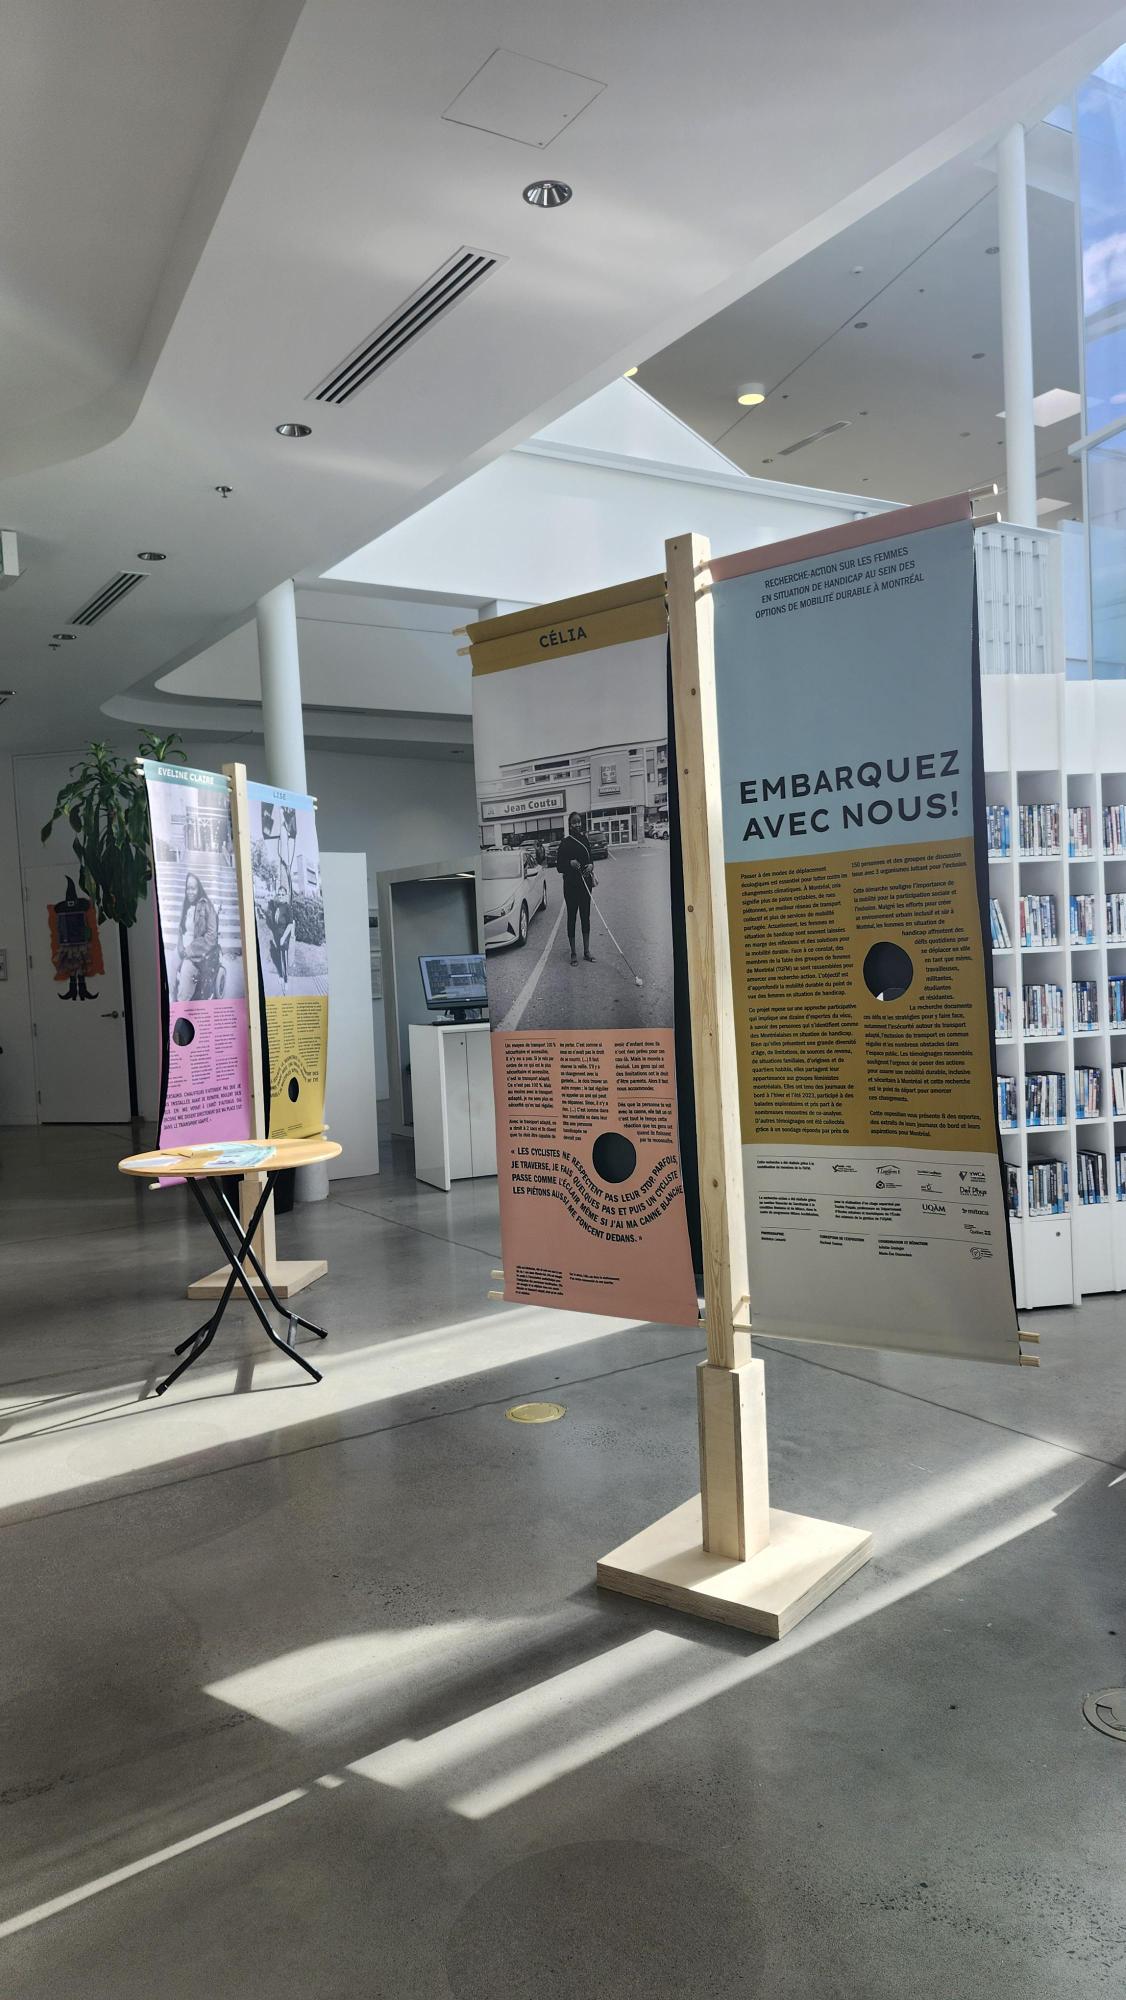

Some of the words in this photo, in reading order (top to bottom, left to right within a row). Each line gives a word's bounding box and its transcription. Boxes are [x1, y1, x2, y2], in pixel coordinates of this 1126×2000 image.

[761, 595, 772, 603] EN
[774, 585, 810, 601] SITUATION
[812, 583, 822, 592] DE
[824, 572, 863, 590] HANDICAP
[865, 570, 876, 579] AU
[878, 565, 897, 576] SEIN
[899, 560, 915, 571] DES
[765, 563, 837, 588] RECHERCHE-ACTION
[840, 560, 855, 570] SUR
[858, 556, 871, 566] LES
[874, 547, 908, 562] FEMMES
[755, 605, 786, 619] OPTIONS
[788, 602, 798, 611] DE
[800, 592, 833, 608] MOBILITÉ
[836, 585, 871, 600] DURABLE
[874, 582, 879, 592] À
[881, 573, 924, 590] MONTRÉAL
[539, 626, 587, 648] CÉLIA
[158, 768, 188, 779] EVELINE
[190, 772, 214, 784] CLAIRE
[274, 791, 286, 800] LISE
[740, 750, 960, 804] EMBARQUEZ
[504, 804, 525, 814] Jean
[528, 799, 557, 810] Coutu
[742, 808, 830, 842] AVEC
[843, 790, 959, 829] NOUS!
[518, 1147, 529, 1155] LES
[531, 1148, 560, 1157] CYCLISTES
[562, 1151, 571, 1160] NE
[572, 1157, 603, 1197] RESPECTENT
[605, 1193, 618, 1202] PAS
[621, 1191, 640, 1202] LEUR
[640, 1176, 656, 1193] STOP.
[652, 1155, 678, 1176] PARFOIS,
[521, 1161, 550, 1172] TRAVERSE,
[552, 1163, 559, 1171] JE
[561, 1165, 573, 1177] FAIS
[573, 1177, 600, 1209] QUELQUES
[602, 1205, 615, 1215] PAS
[629, 1203, 646, 1214] PUIS
[646, 1195, 657, 1206] UN
[655, 1171, 678, 1197] CYCLISTE
[527, 1186, 550, 1196] PIÉTONS
[551, 1190, 569, 1205] AUSSI
[567, 1205, 577, 1218] ME
[576, 1216, 603, 1239] FONCENT
[606, 1233, 637, 1242] DEDANS.
[534, 1175, 557, 1184] COMME
[559, 1178, 580, 1204] L'ÉCLAIR
[580, 1203, 599, 1222] MÊME
[600, 1218, 608, 1226] SI
[610, 1220, 623, 1228] J'AI
[626, 1220, 638, 1228] MA
[640, 1208, 662, 1225] CANNE
[660, 1185, 683, 1211] BLANCHE
